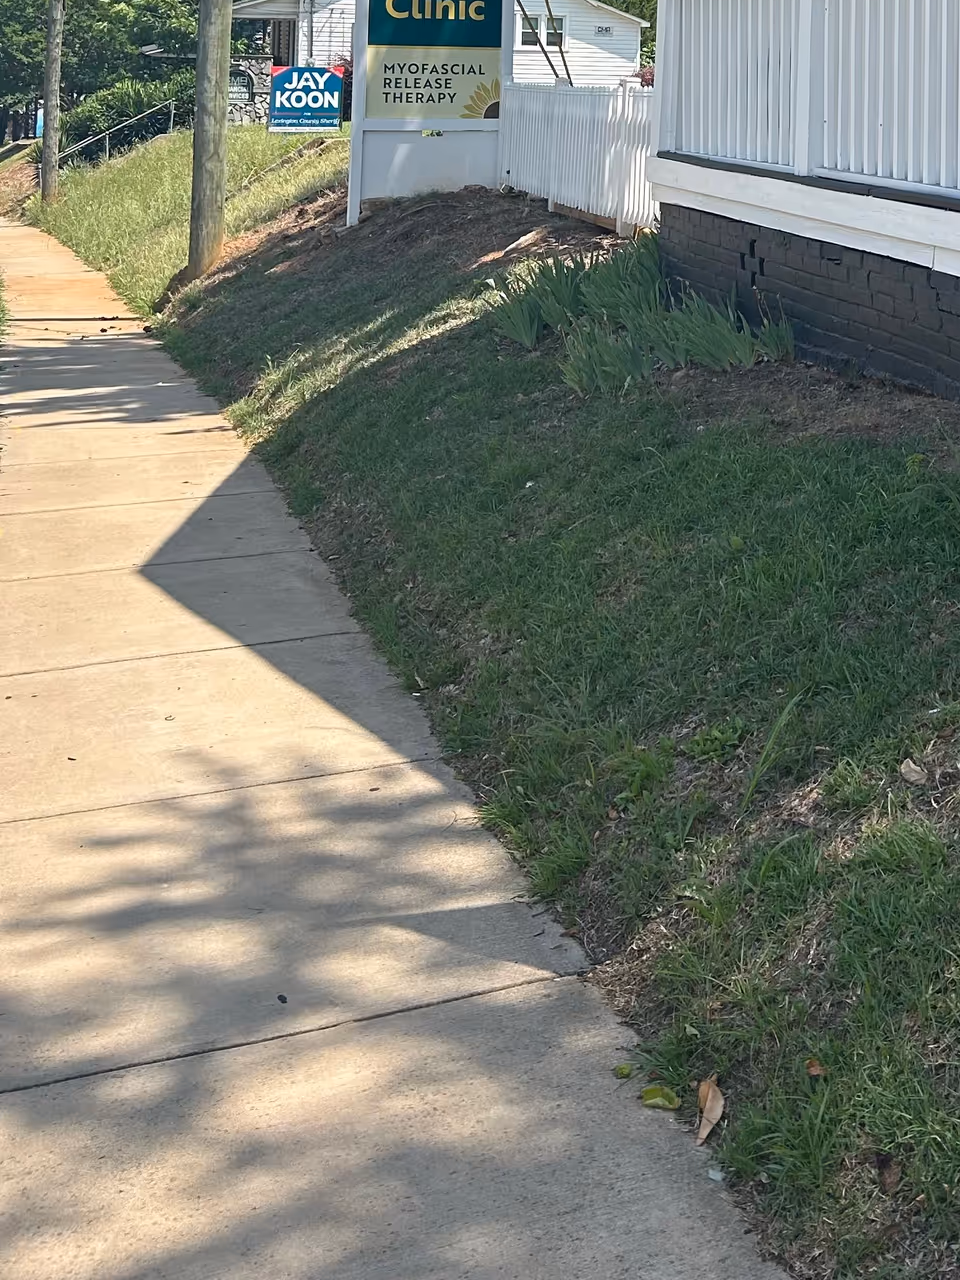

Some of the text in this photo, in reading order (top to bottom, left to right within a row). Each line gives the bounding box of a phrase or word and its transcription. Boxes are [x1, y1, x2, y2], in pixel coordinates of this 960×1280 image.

[383, 62, 486, 76] MYOFASCIAL
[283, 72, 332, 90] JAY
[383, 77, 453, 89] RELEASE
[275, 90, 339, 109] KOON
[382, 91, 458, 104] THERAPY
[320, 117, 340, 125] Sheriff
